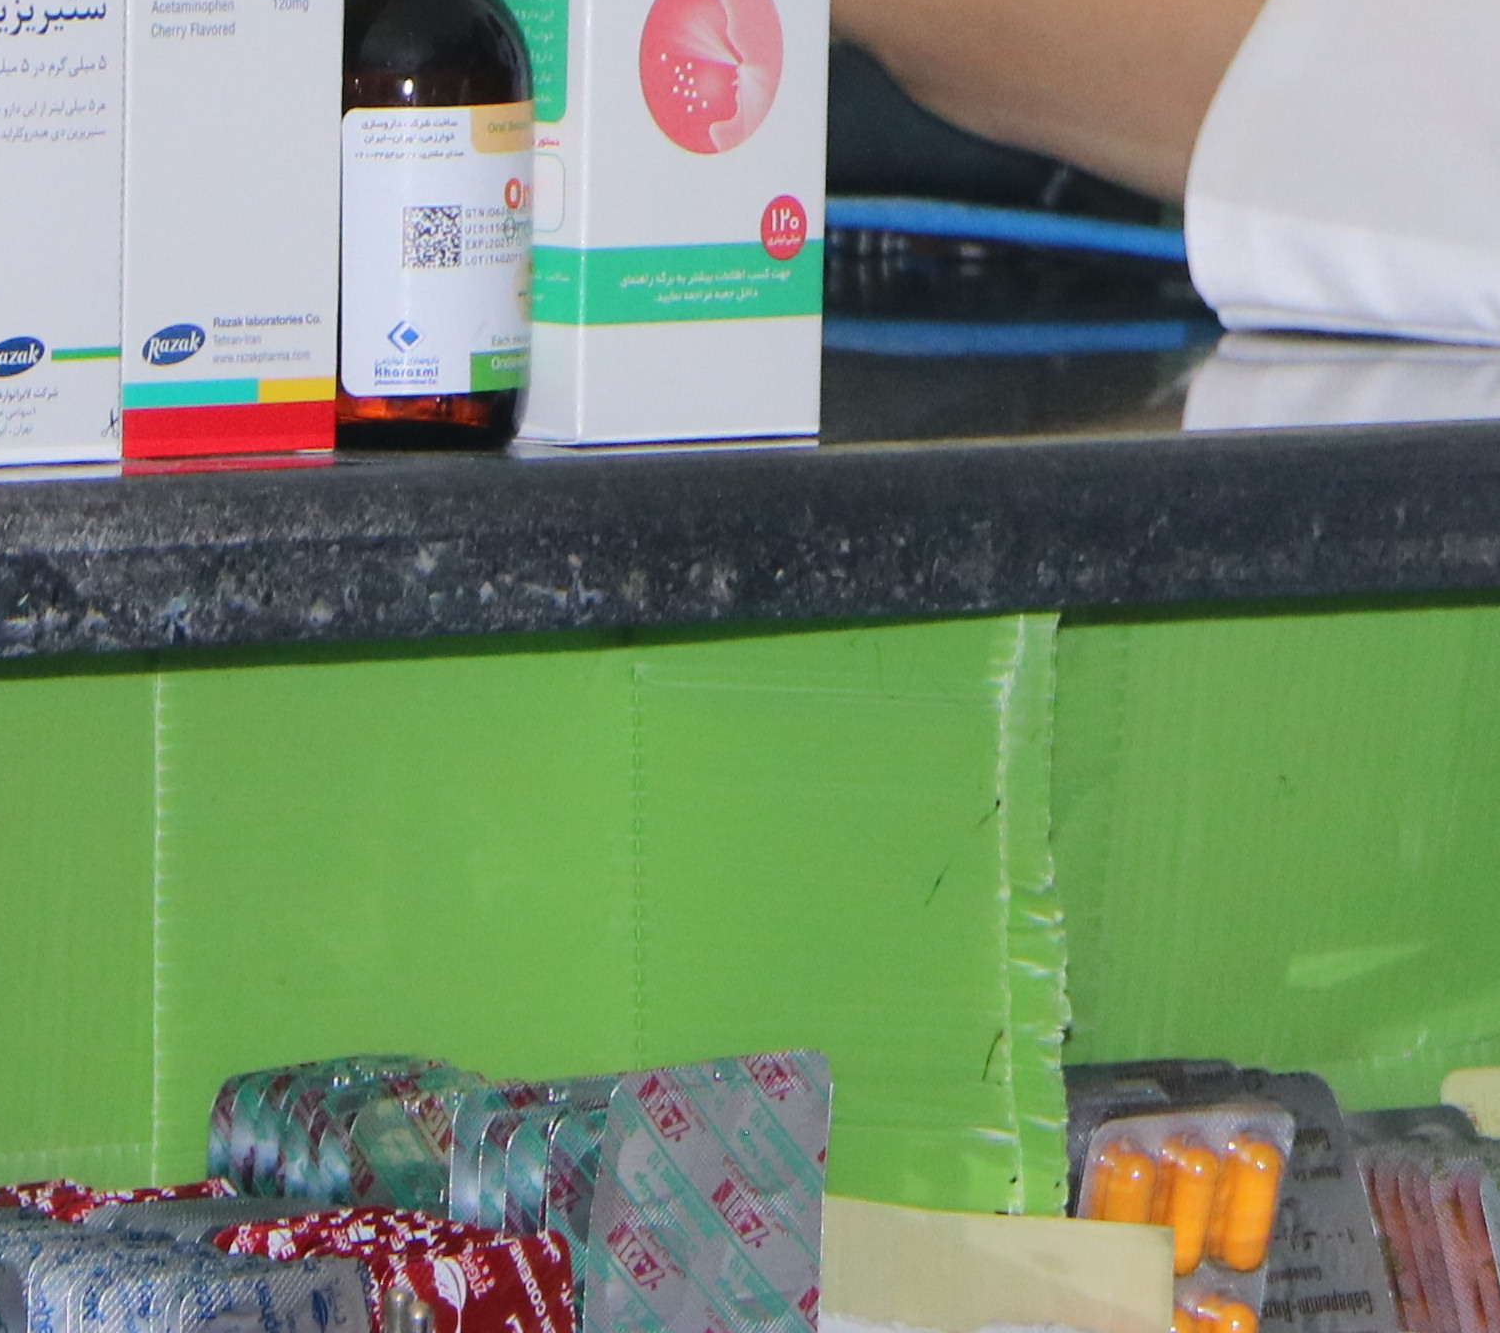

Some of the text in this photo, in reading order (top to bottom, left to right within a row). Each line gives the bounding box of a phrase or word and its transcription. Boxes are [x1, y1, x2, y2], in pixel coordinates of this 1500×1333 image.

[151, 22, 236, 40] Cherry Flavored
[770, 208, 800, 233] ۱۲۰
[213, 313, 322, 328] Razak laboratories Co.
[146, 330, 202, 365] Razak
[507, 1238, 548, 1317] CODEINE
